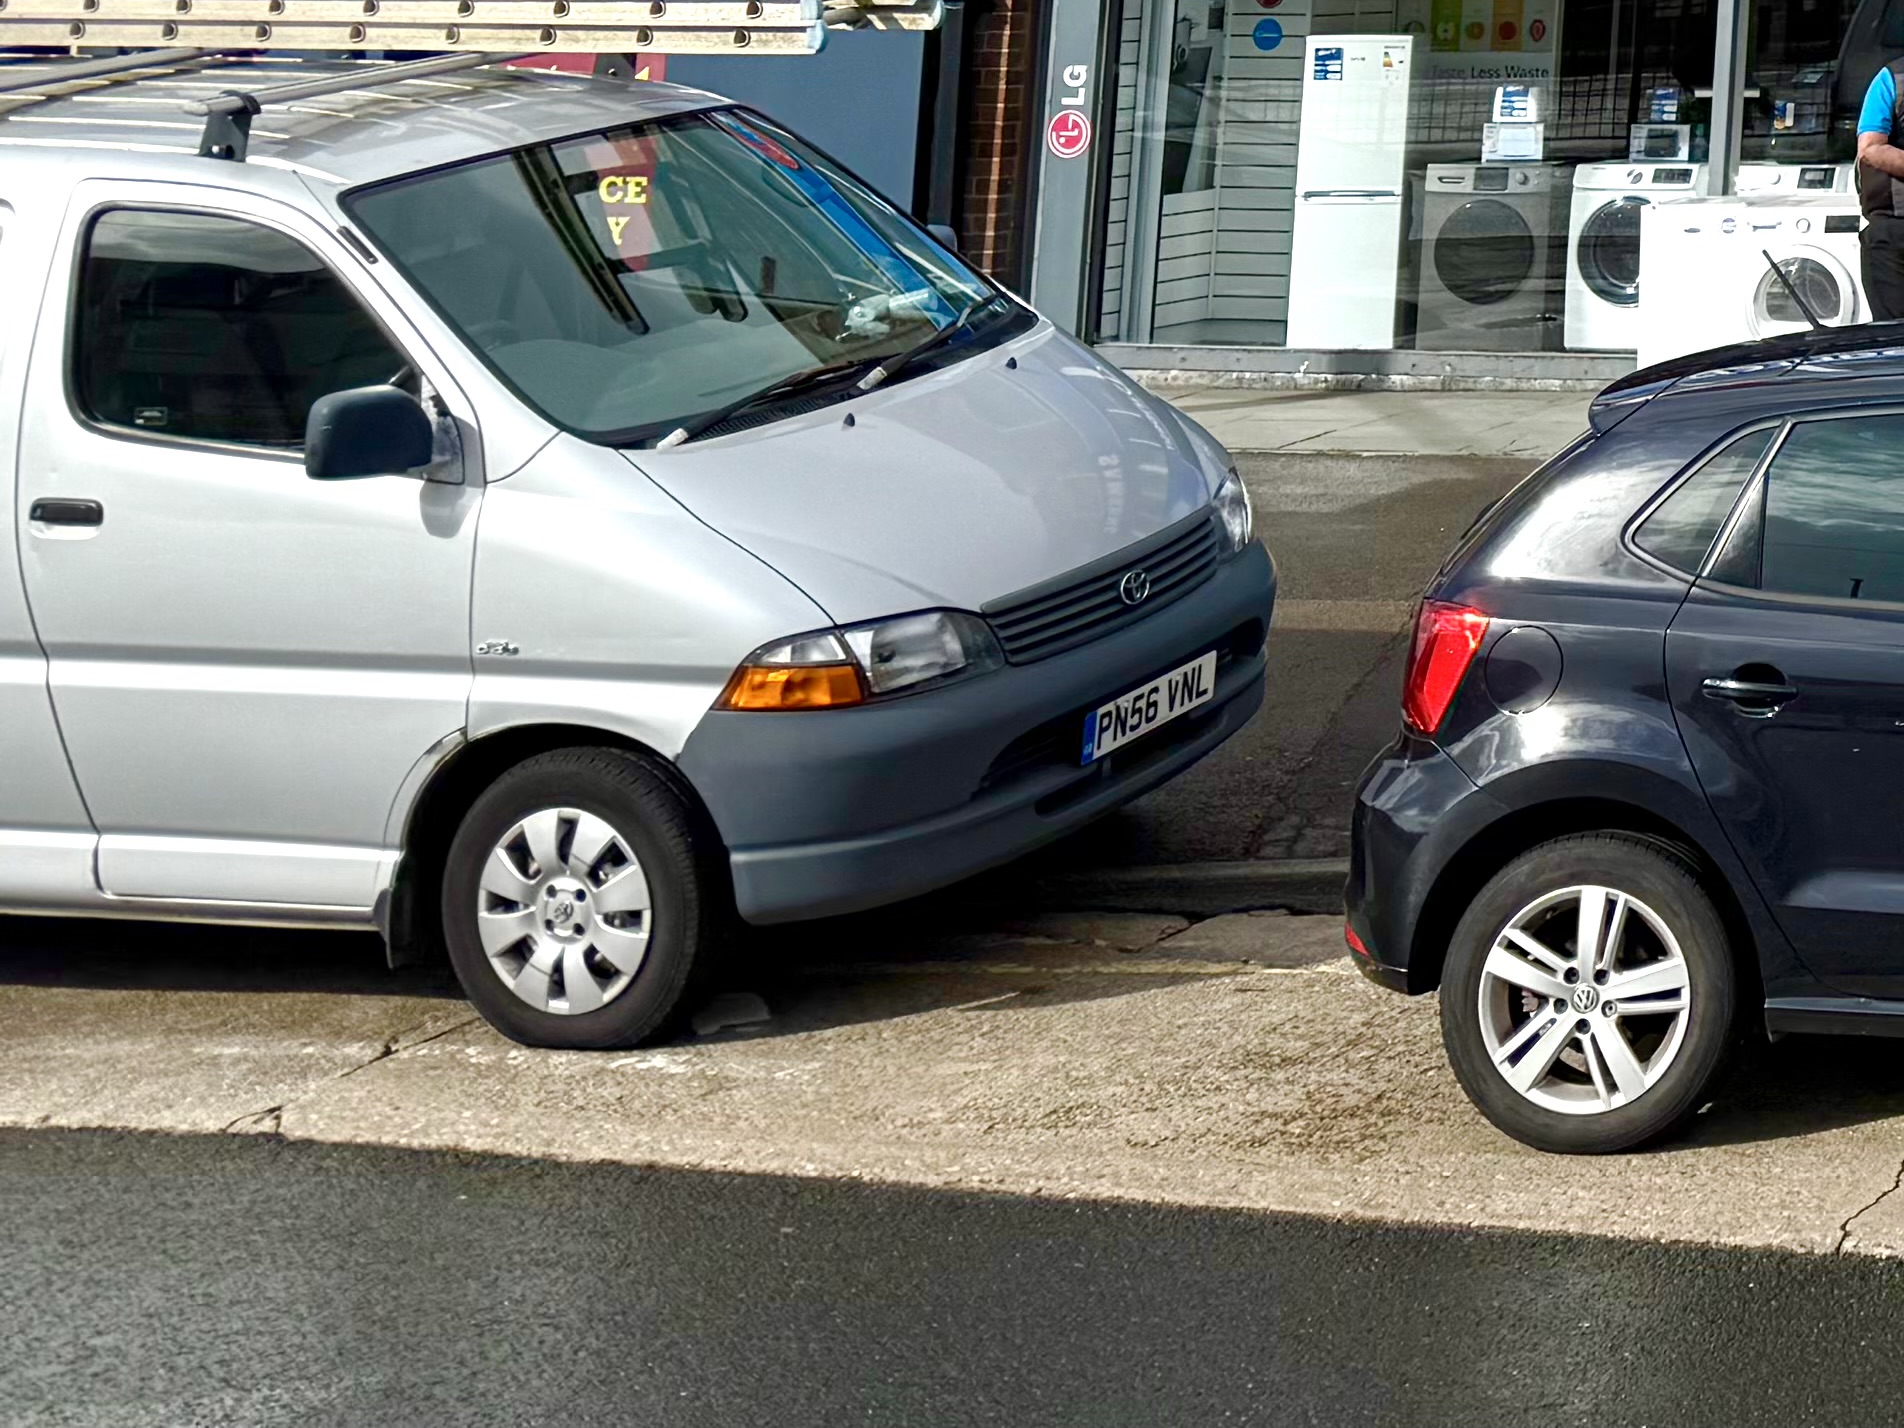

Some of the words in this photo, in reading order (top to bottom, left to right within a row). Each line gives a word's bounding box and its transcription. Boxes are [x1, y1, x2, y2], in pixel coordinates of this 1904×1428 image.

[1062, 63, 1089, 106] LG
[1470, 65, 1502, 79] Less
[1504, 65, 1550, 79] Waste
[1096, 686, 1160, 752] PN56
[1167, 663, 1210, 710] VNL
